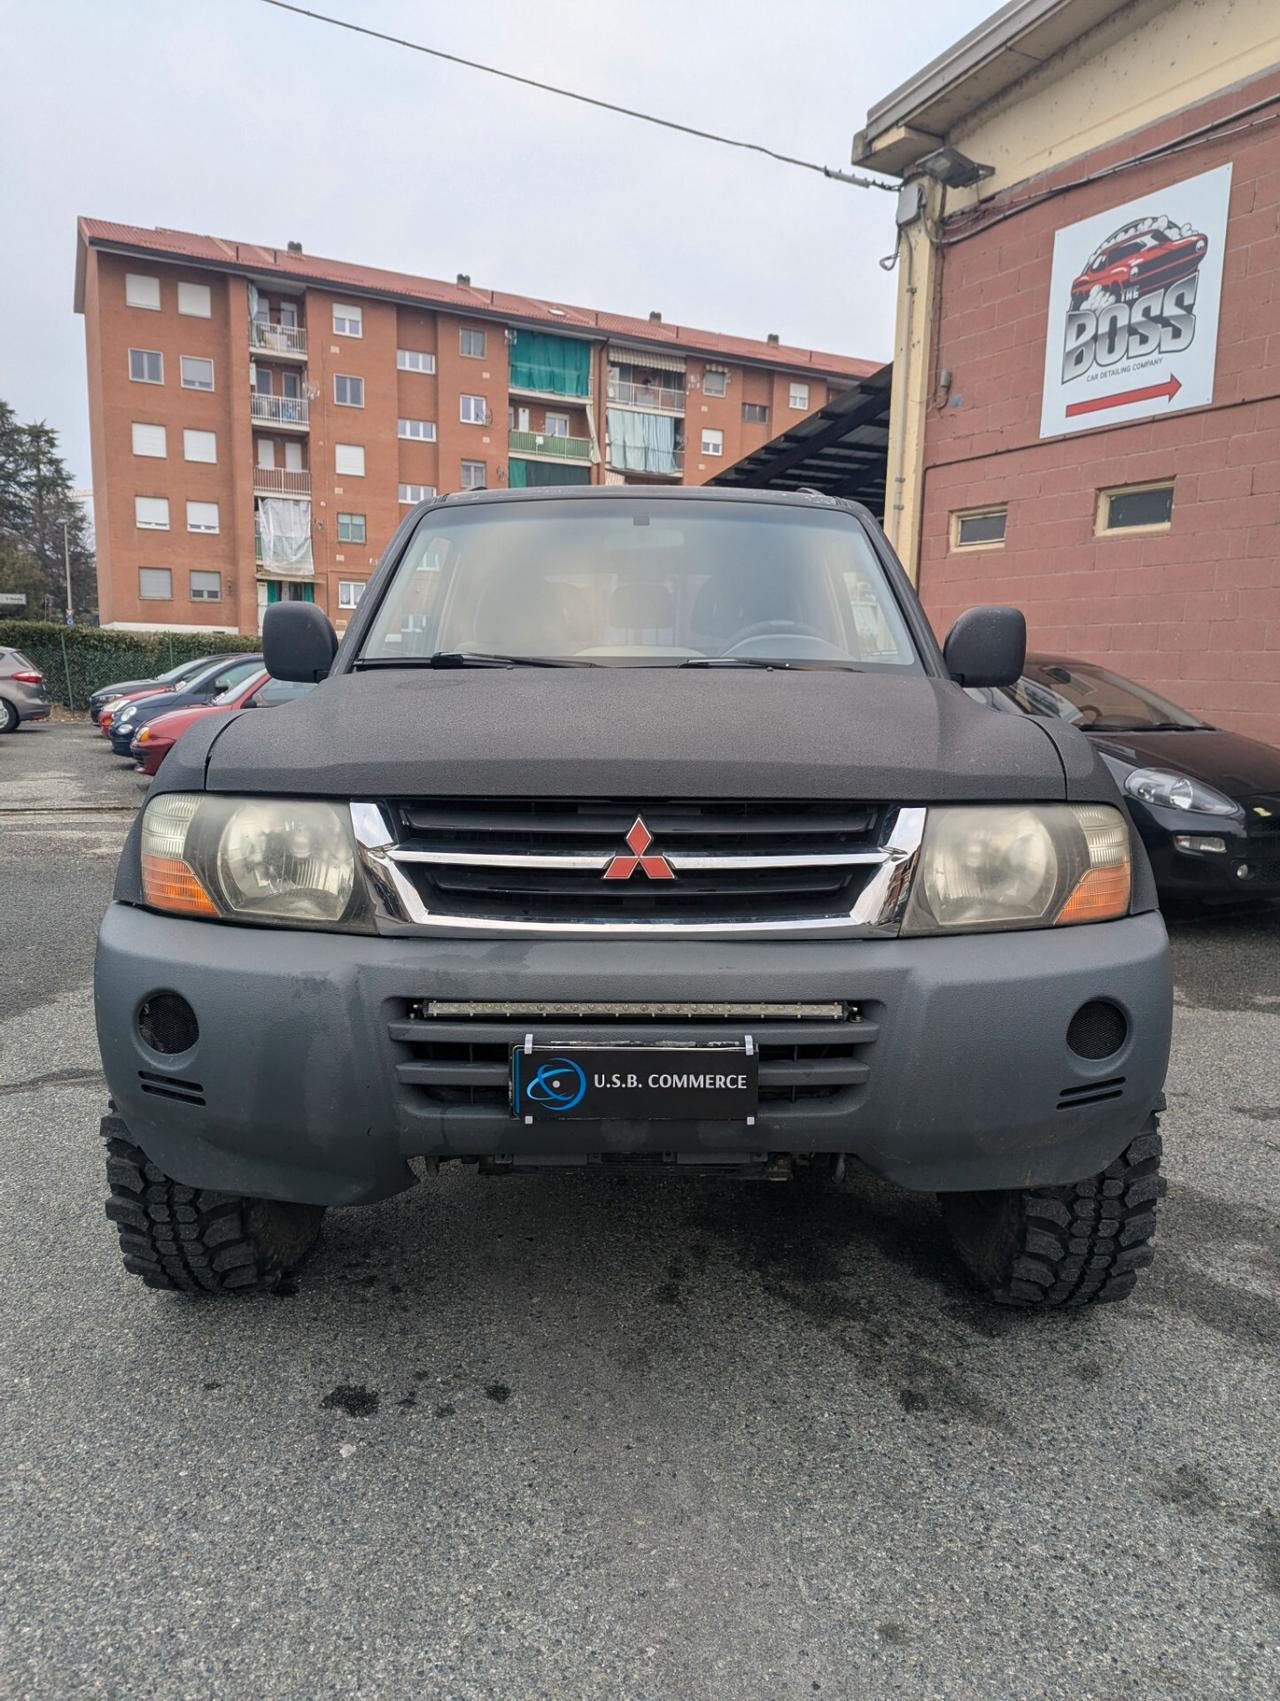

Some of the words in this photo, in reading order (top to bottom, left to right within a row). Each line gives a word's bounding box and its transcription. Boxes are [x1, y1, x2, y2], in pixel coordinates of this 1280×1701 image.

[1120, 285, 1140, 302] THE
[1061, 270, 1200, 384] BOSS
[1086, 373, 1099, 382] CAR
[1100, 365, 1131, 379] DETAILING
[1132, 358, 1163, 371] COMPANY
[593, 1074, 642, 1088] U.S.B.
[648, 1074, 748, 1089] COMMERCE
